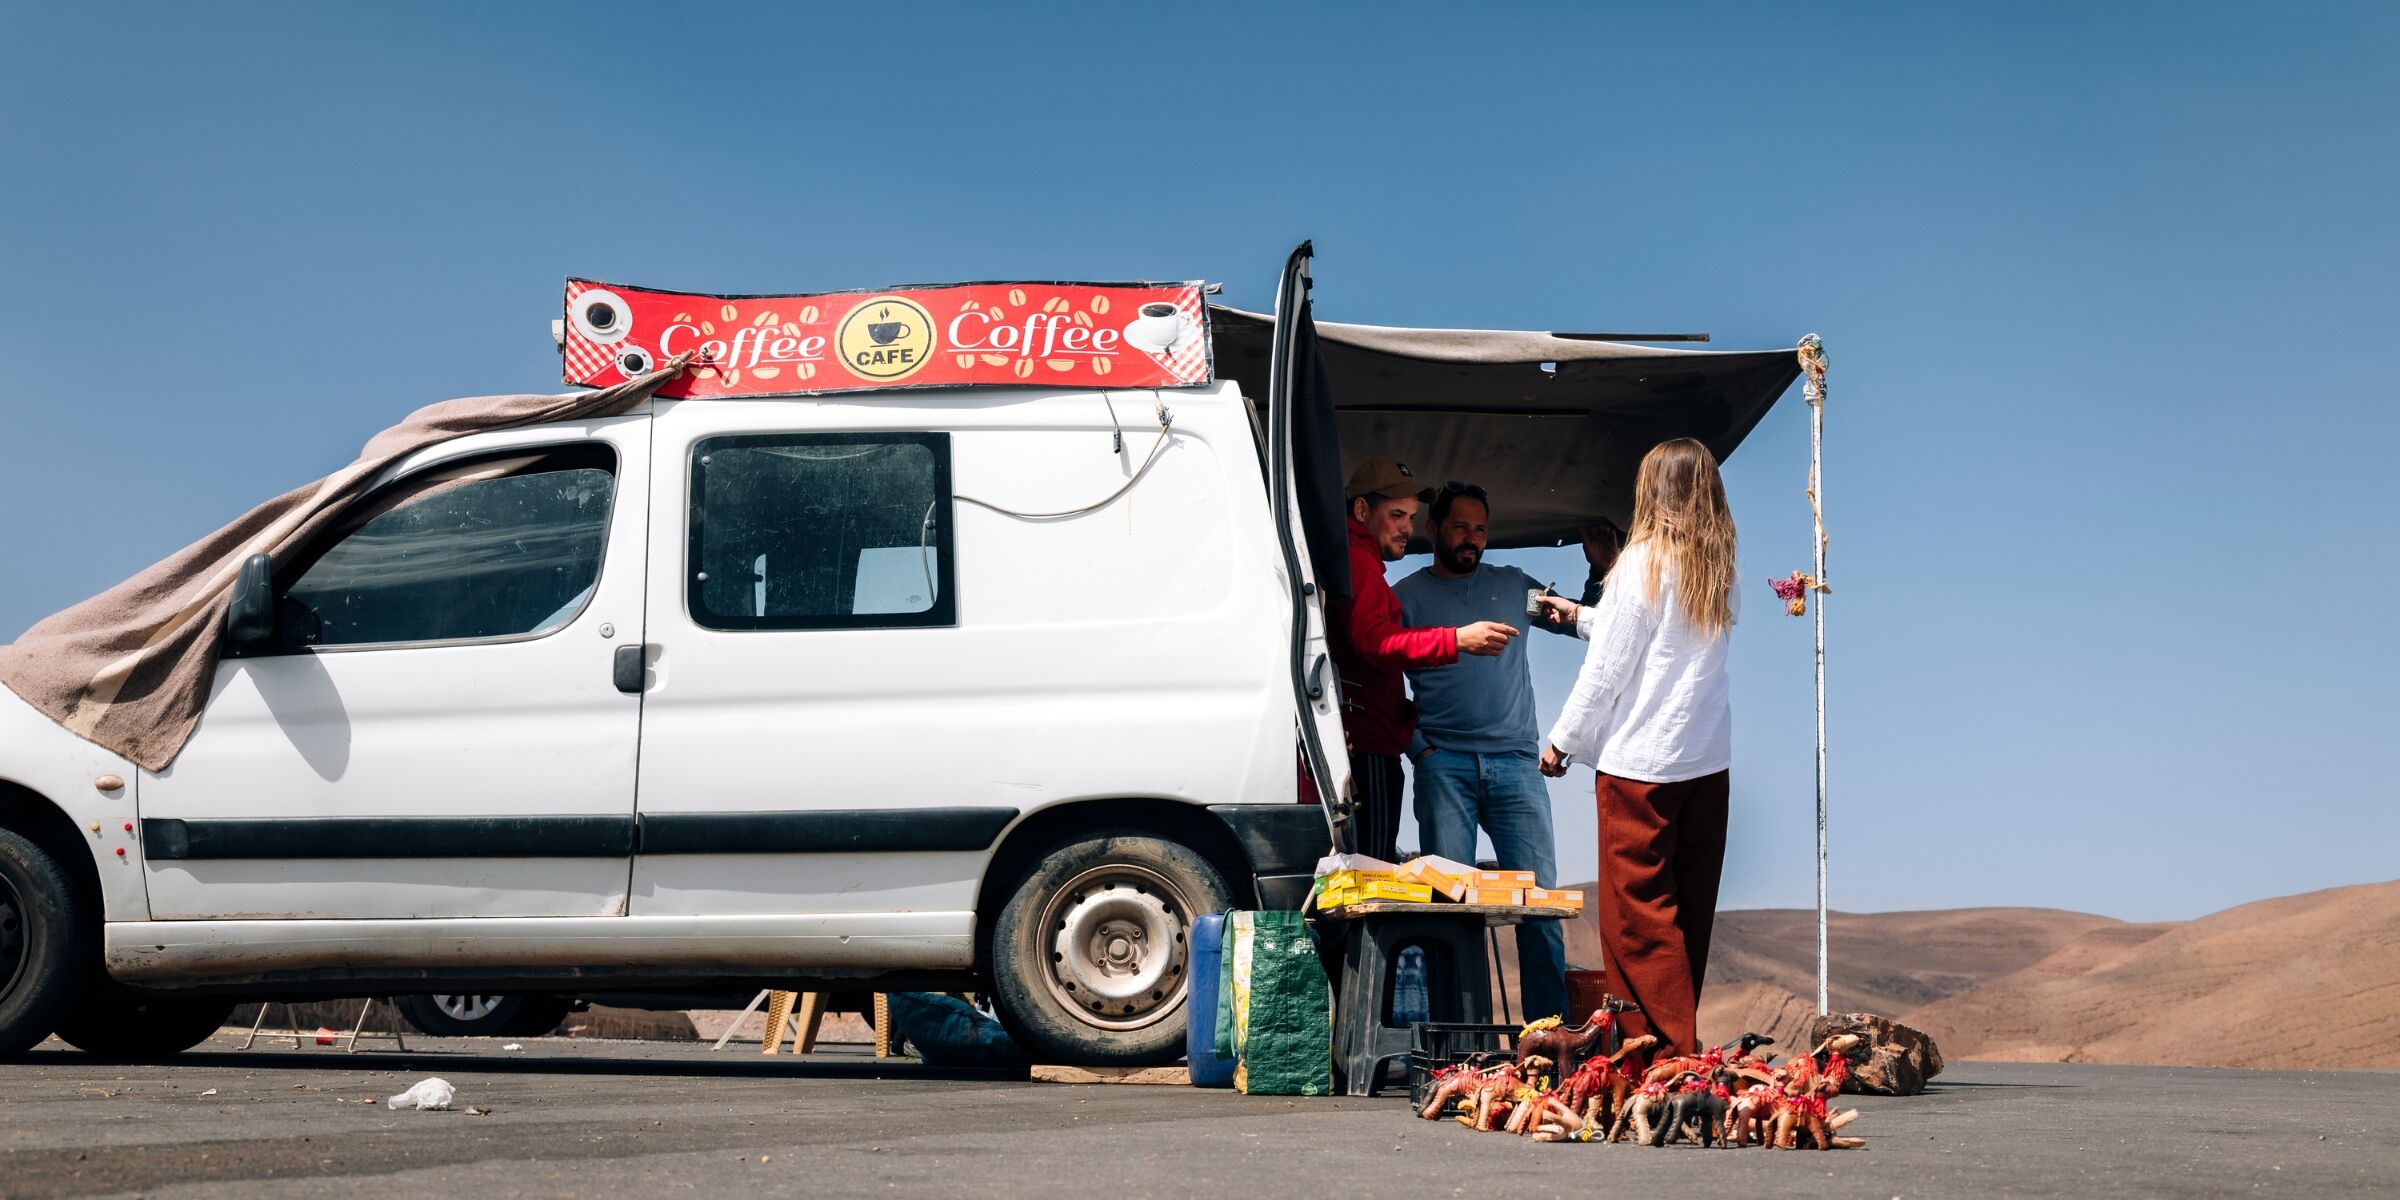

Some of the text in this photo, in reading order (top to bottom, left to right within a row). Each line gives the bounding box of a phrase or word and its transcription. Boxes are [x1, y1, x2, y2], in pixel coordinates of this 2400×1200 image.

[659, 324, 826, 368] Coffee
[948, 312, 1119, 357] Coffee
[856, 348, 914, 366] CAFE
